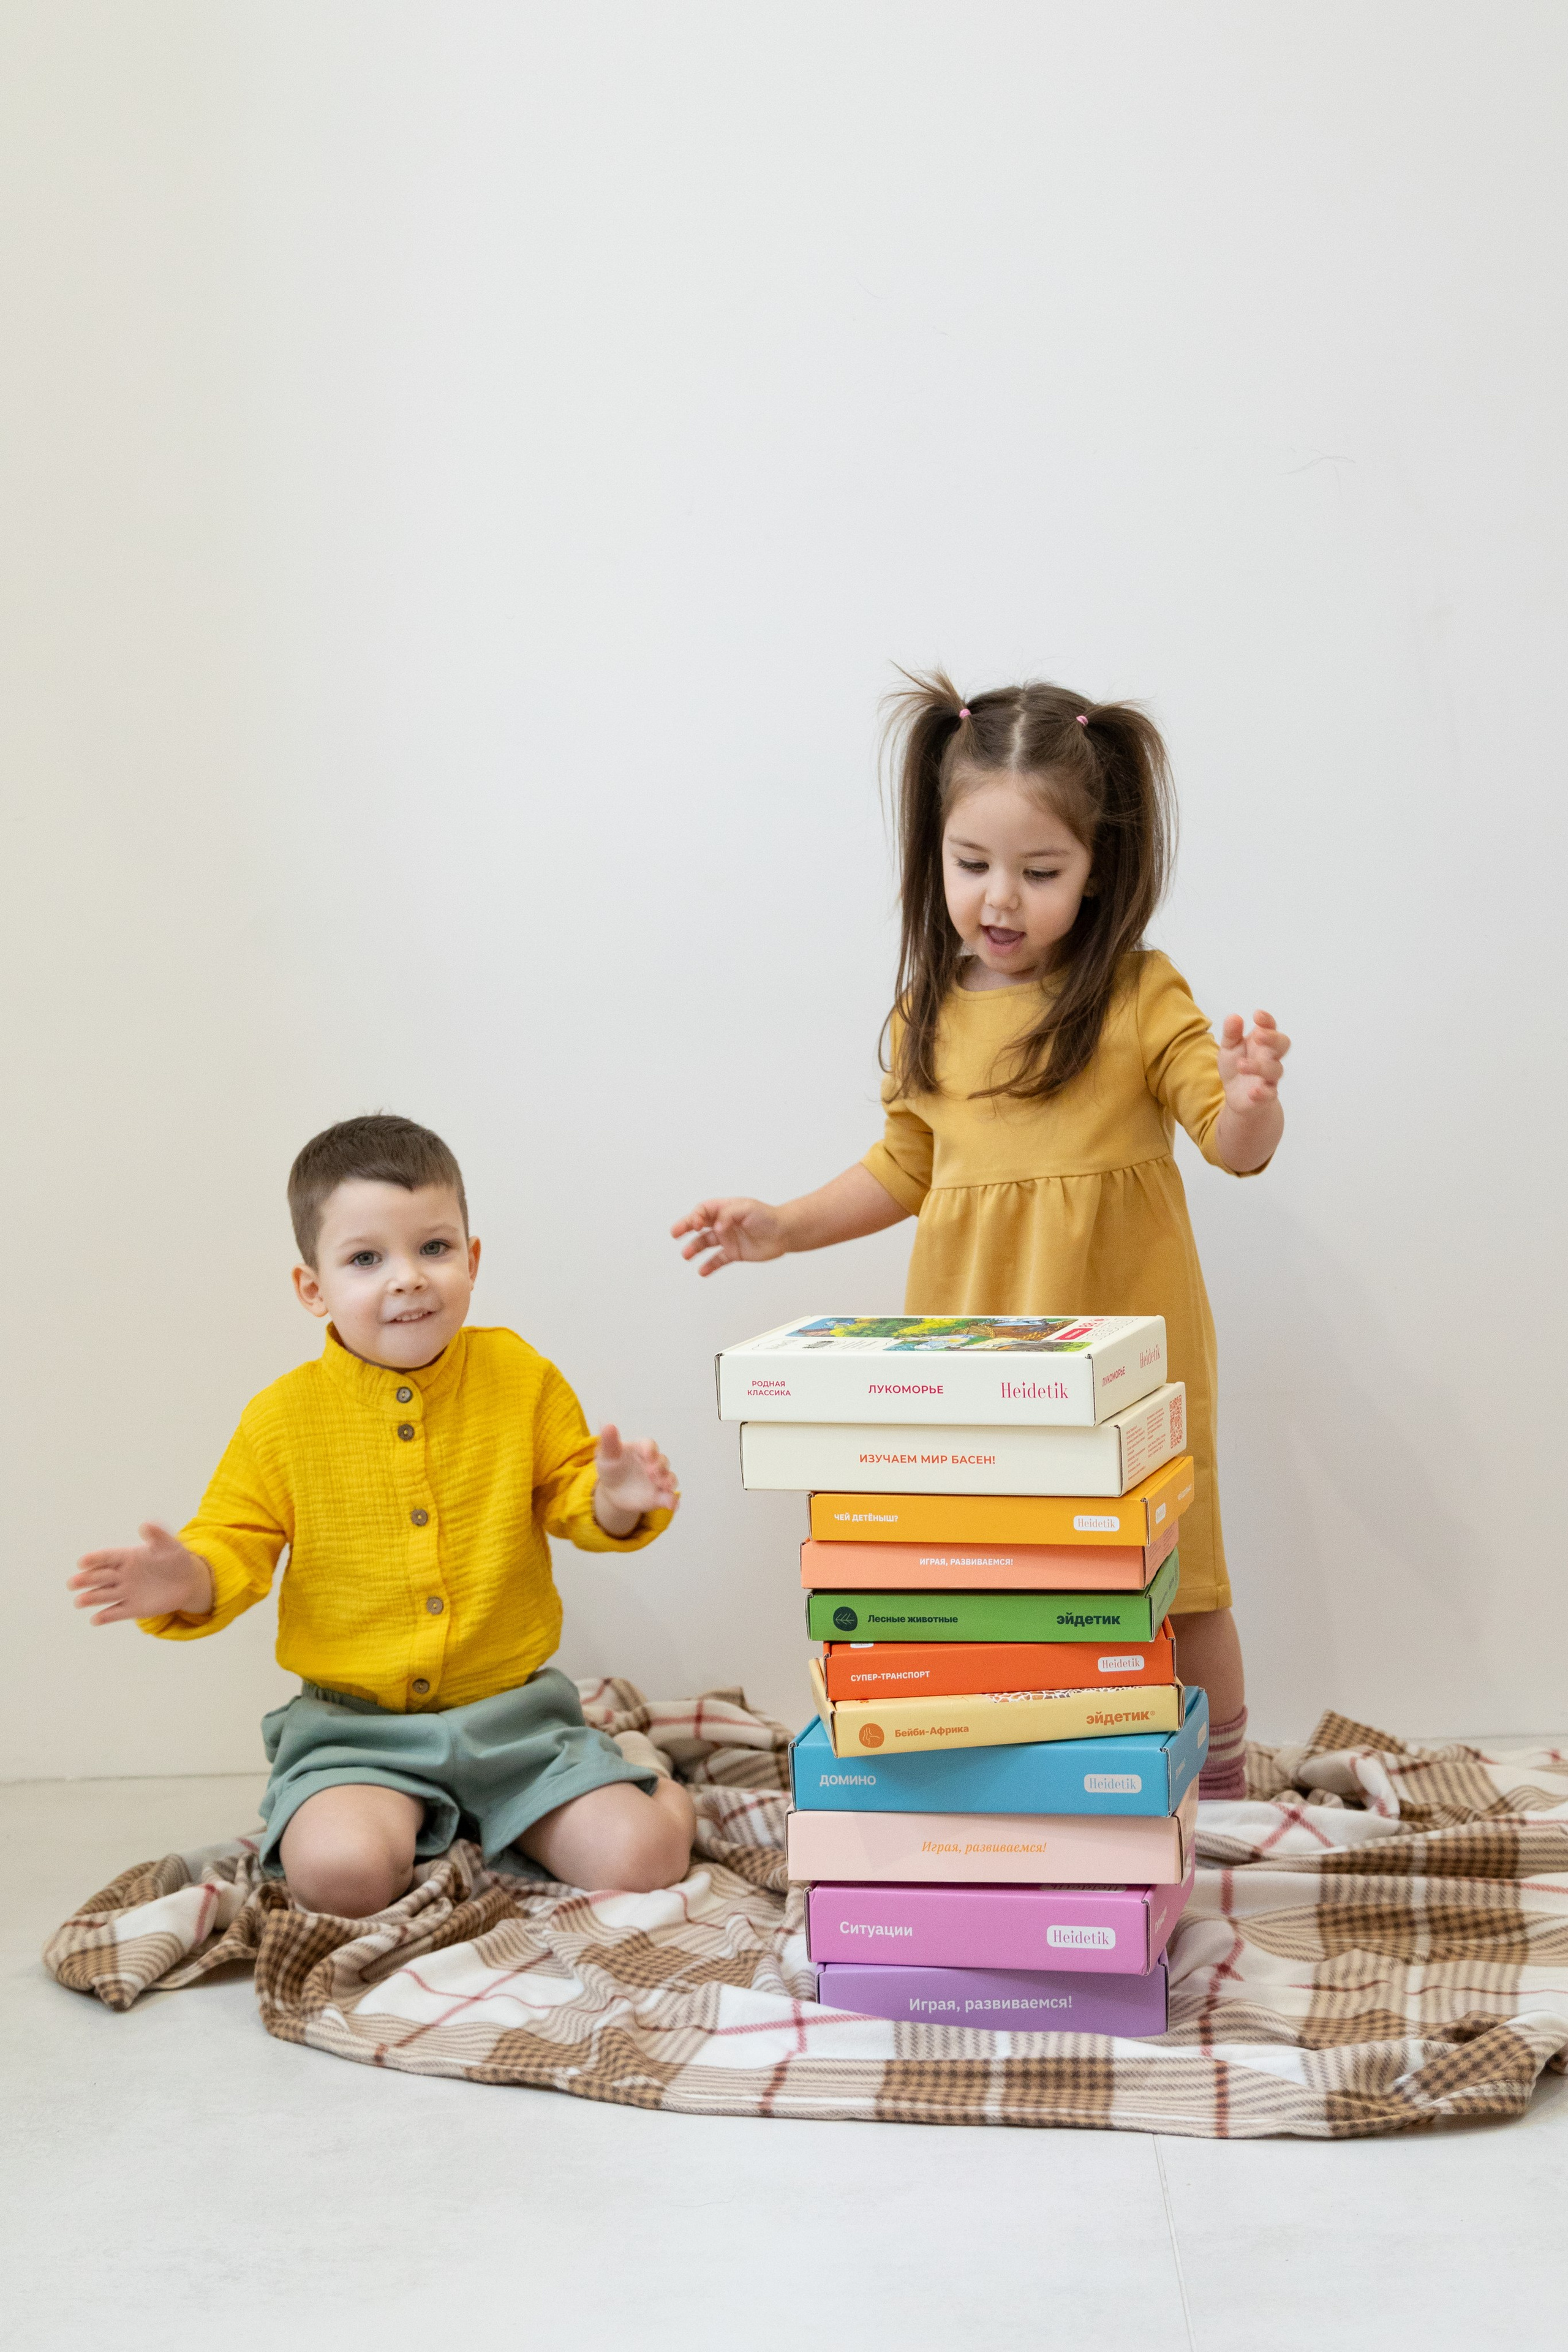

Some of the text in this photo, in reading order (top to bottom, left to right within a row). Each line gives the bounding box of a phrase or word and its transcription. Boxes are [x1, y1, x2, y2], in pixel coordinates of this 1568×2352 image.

[1139, 1344, 1161, 1369] Heidetik
[1102, 1366, 1126, 1387] ЛУКОМОРЬЕ
[868, 1385, 944, 1394] ЛУКОМОРЬЕ
[1001, 1381, 1068, 1399] Heidetik
[859, 1454, 995, 1464] ИЗУЧАЕМ МИР БАСЕН!
[834, 1512, 899, 1523] ЧЕЙ ДЕТЁНЫШ?
[1077, 1518, 1115, 1529] Heidetik
[867, 1615, 906, 1623] Лесные
[1057, 1612, 1120, 1627] эйдетик
[1102, 1658, 1140, 1670] Heidetik
[850, 1670, 930, 1682] СУПЕР-ТРАНСПОРТ
[895, 1726, 970, 1738] Бейби-Африка
[819, 1774, 876, 1787] ДОМИНО
[1090, 1777, 1136, 1790] Heidetik
[922, 1841, 1047, 1855] Играя, развиваемся!
[839, 1921, 913, 1938] Ситуации
[1053, 1930, 1109, 1945] Heidetik
[909, 1996, 1072, 2014] Играя, развиваемся!
